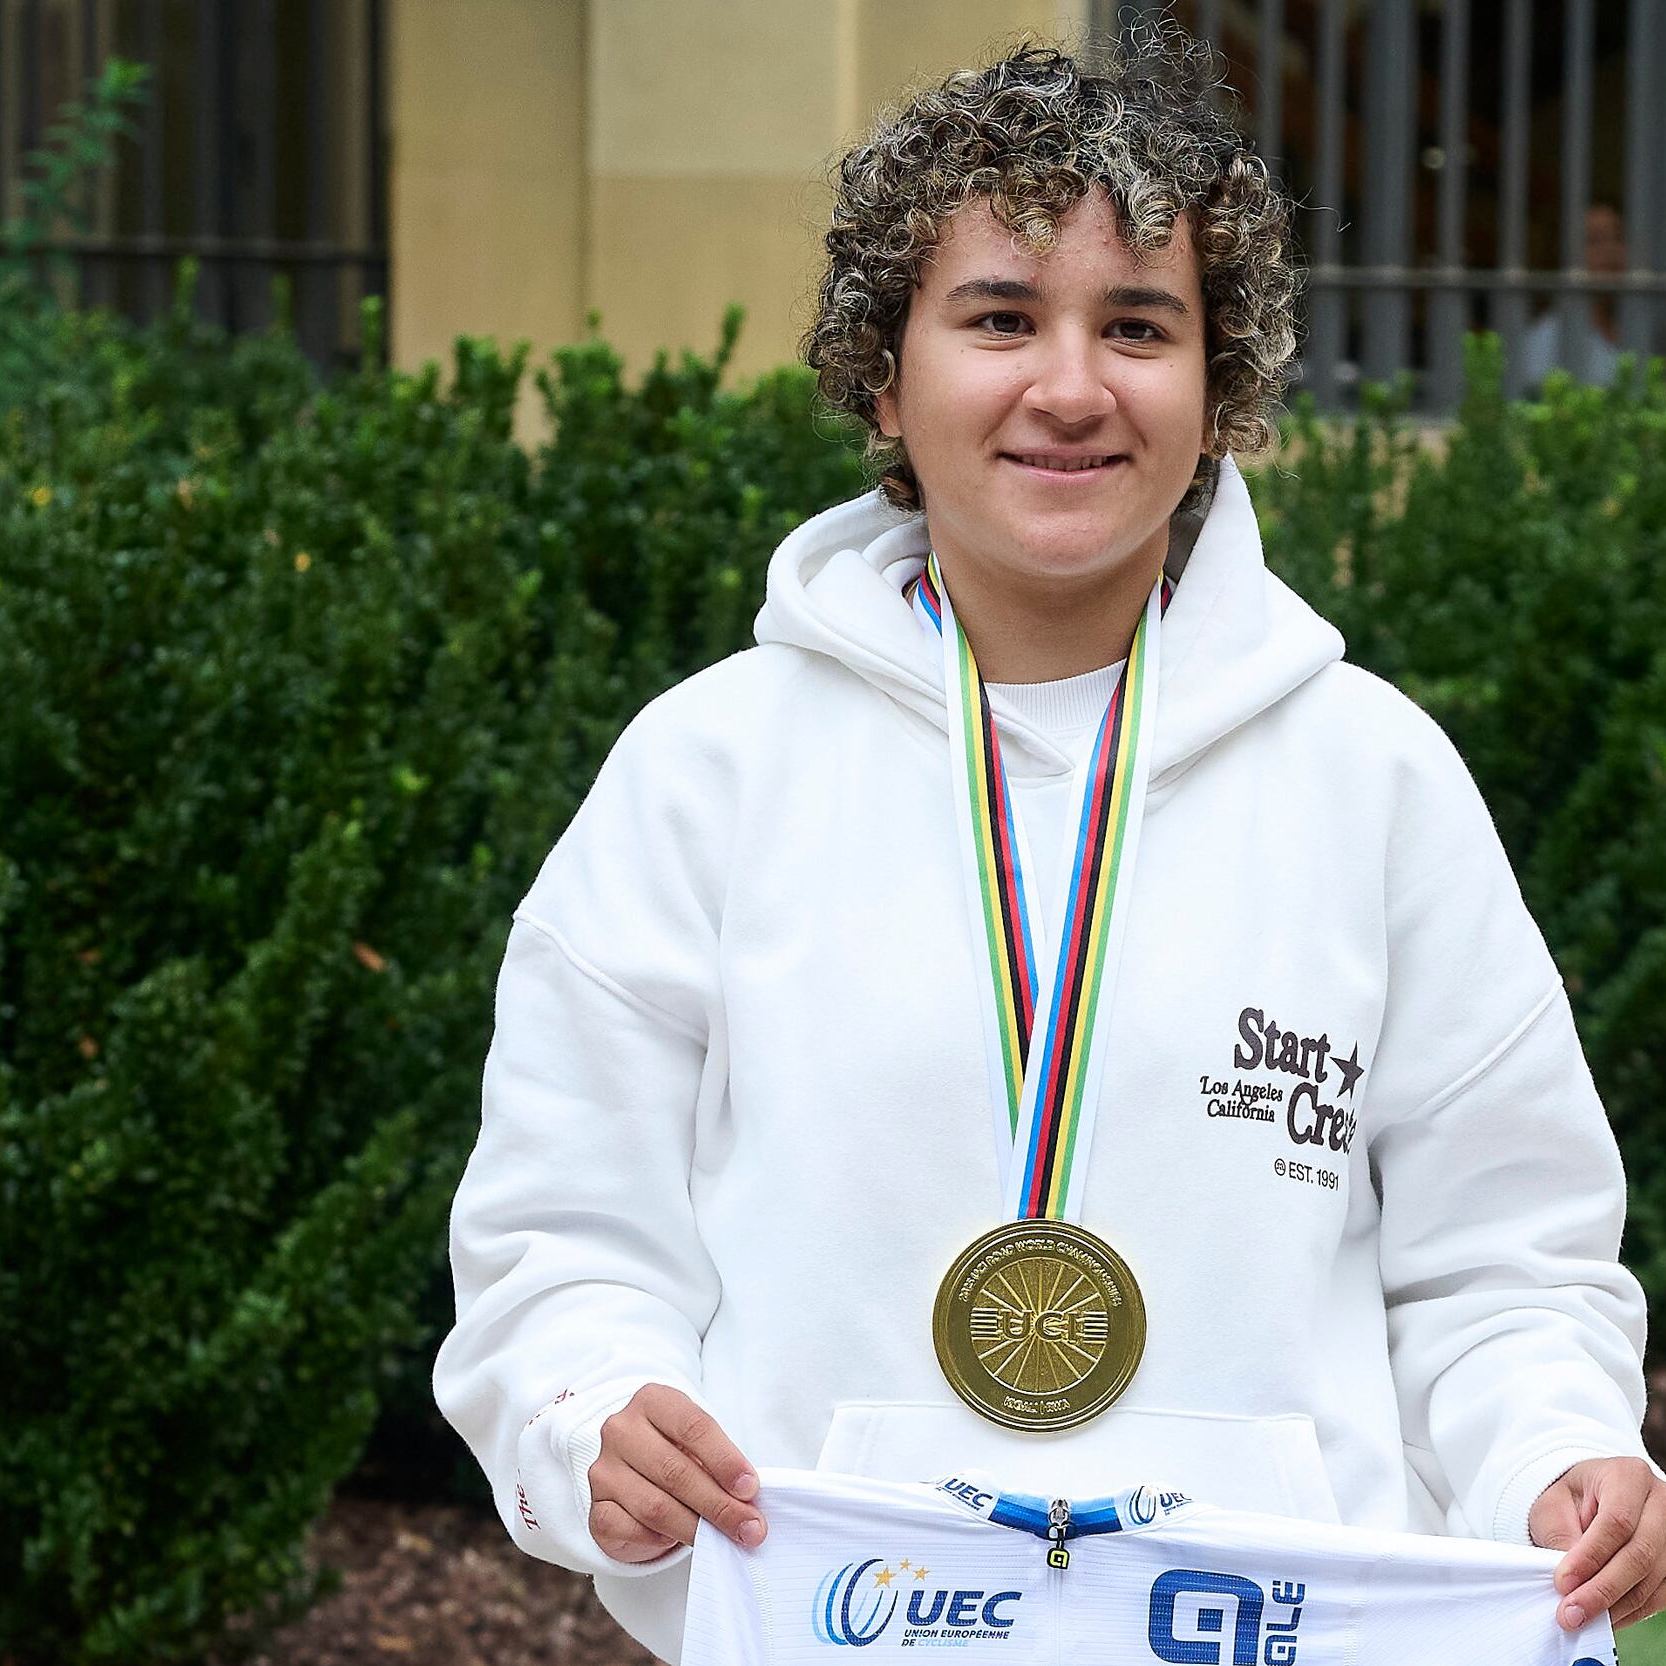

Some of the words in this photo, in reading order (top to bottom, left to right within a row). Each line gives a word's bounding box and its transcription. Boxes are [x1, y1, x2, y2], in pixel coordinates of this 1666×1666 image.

[1234, 1007, 1331, 1083] Start
[1200, 1076, 1229, 1095] Los
[1232, 1080, 1283, 1105] Angeles
[1207, 1099, 1275, 1122] California
[1288, 1161, 1314, 1184] EST.
[1316, 1169, 1339, 1191] 1991
[1001, 1310, 1079, 1343] UCI
[944, 1478, 993, 1508] UEC
[906, 1590, 1022, 1628] UEC
[901, 1638, 917, 1647] DE
[904, 1629, 940, 1639] UNION
[940, 1628, 1011, 1640] EUROPÉENNE
